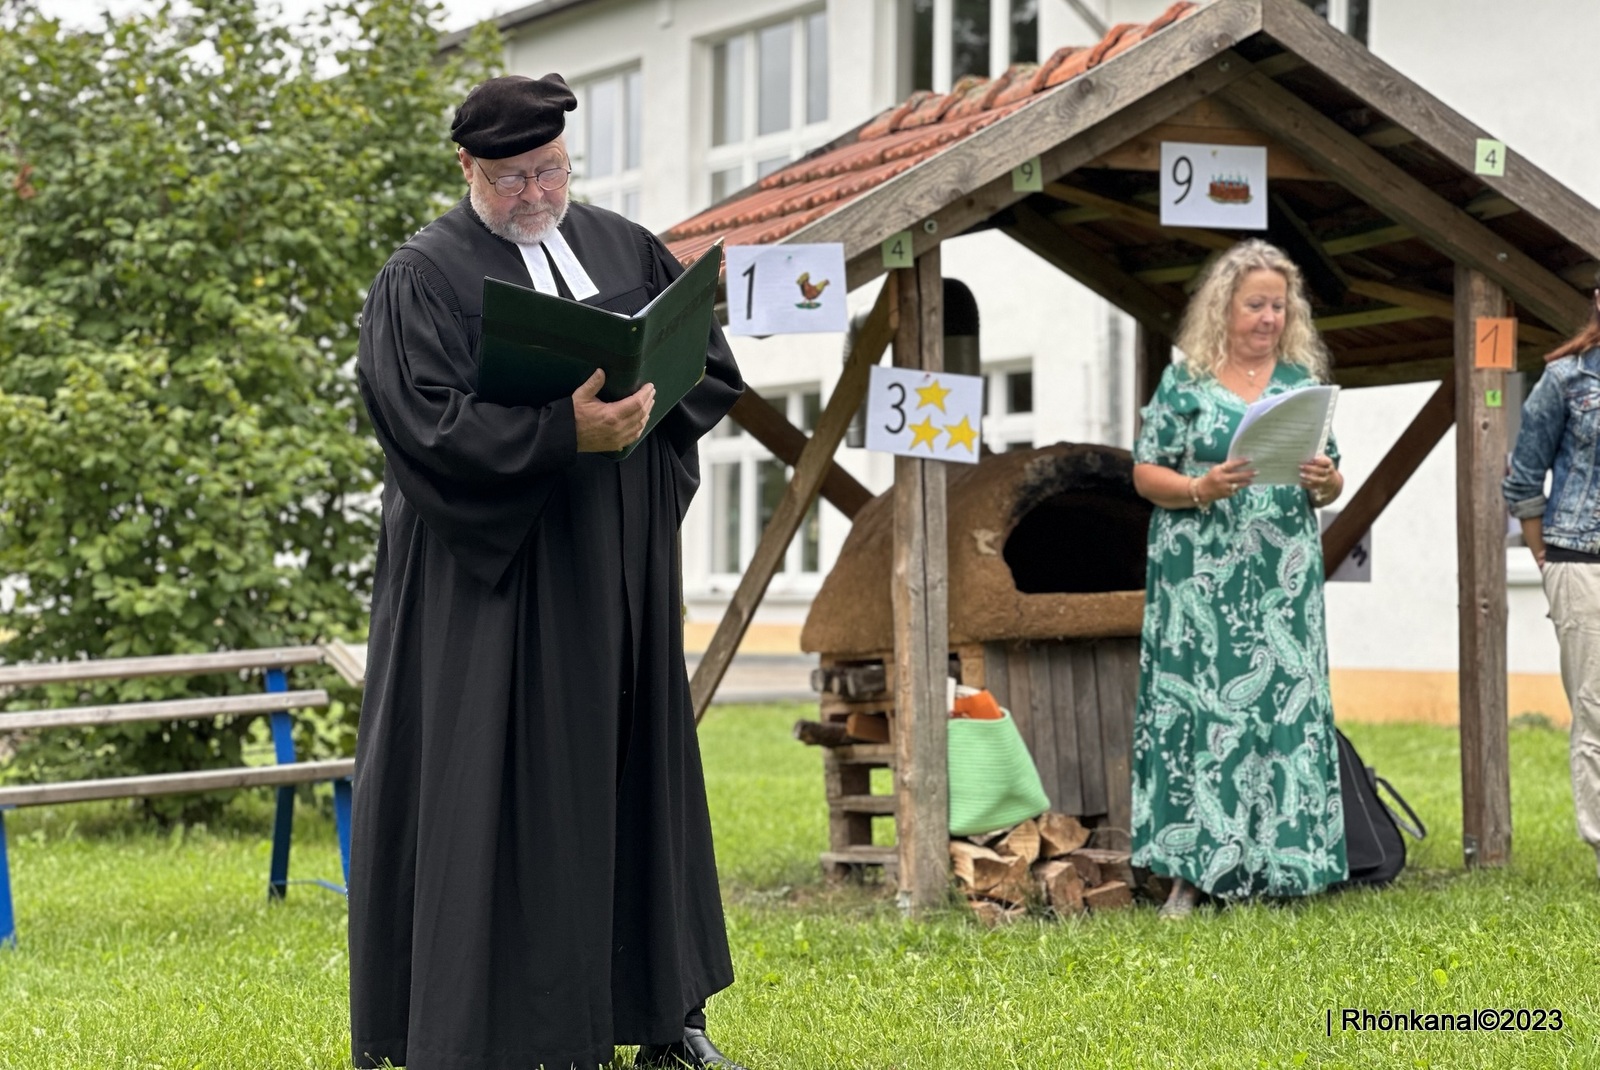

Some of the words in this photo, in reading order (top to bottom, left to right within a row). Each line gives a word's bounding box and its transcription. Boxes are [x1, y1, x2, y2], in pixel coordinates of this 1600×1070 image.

[1021, 163, 1033, 182] 9
[1484, 149, 1498, 169] 4
[1172, 156, 1194, 205] 9
[890, 240, 905, 260] 4
[742, 263, 756, 320] 1
[1480, 323, 1499, 364] 1
[885, 382, 906, 435] 3
